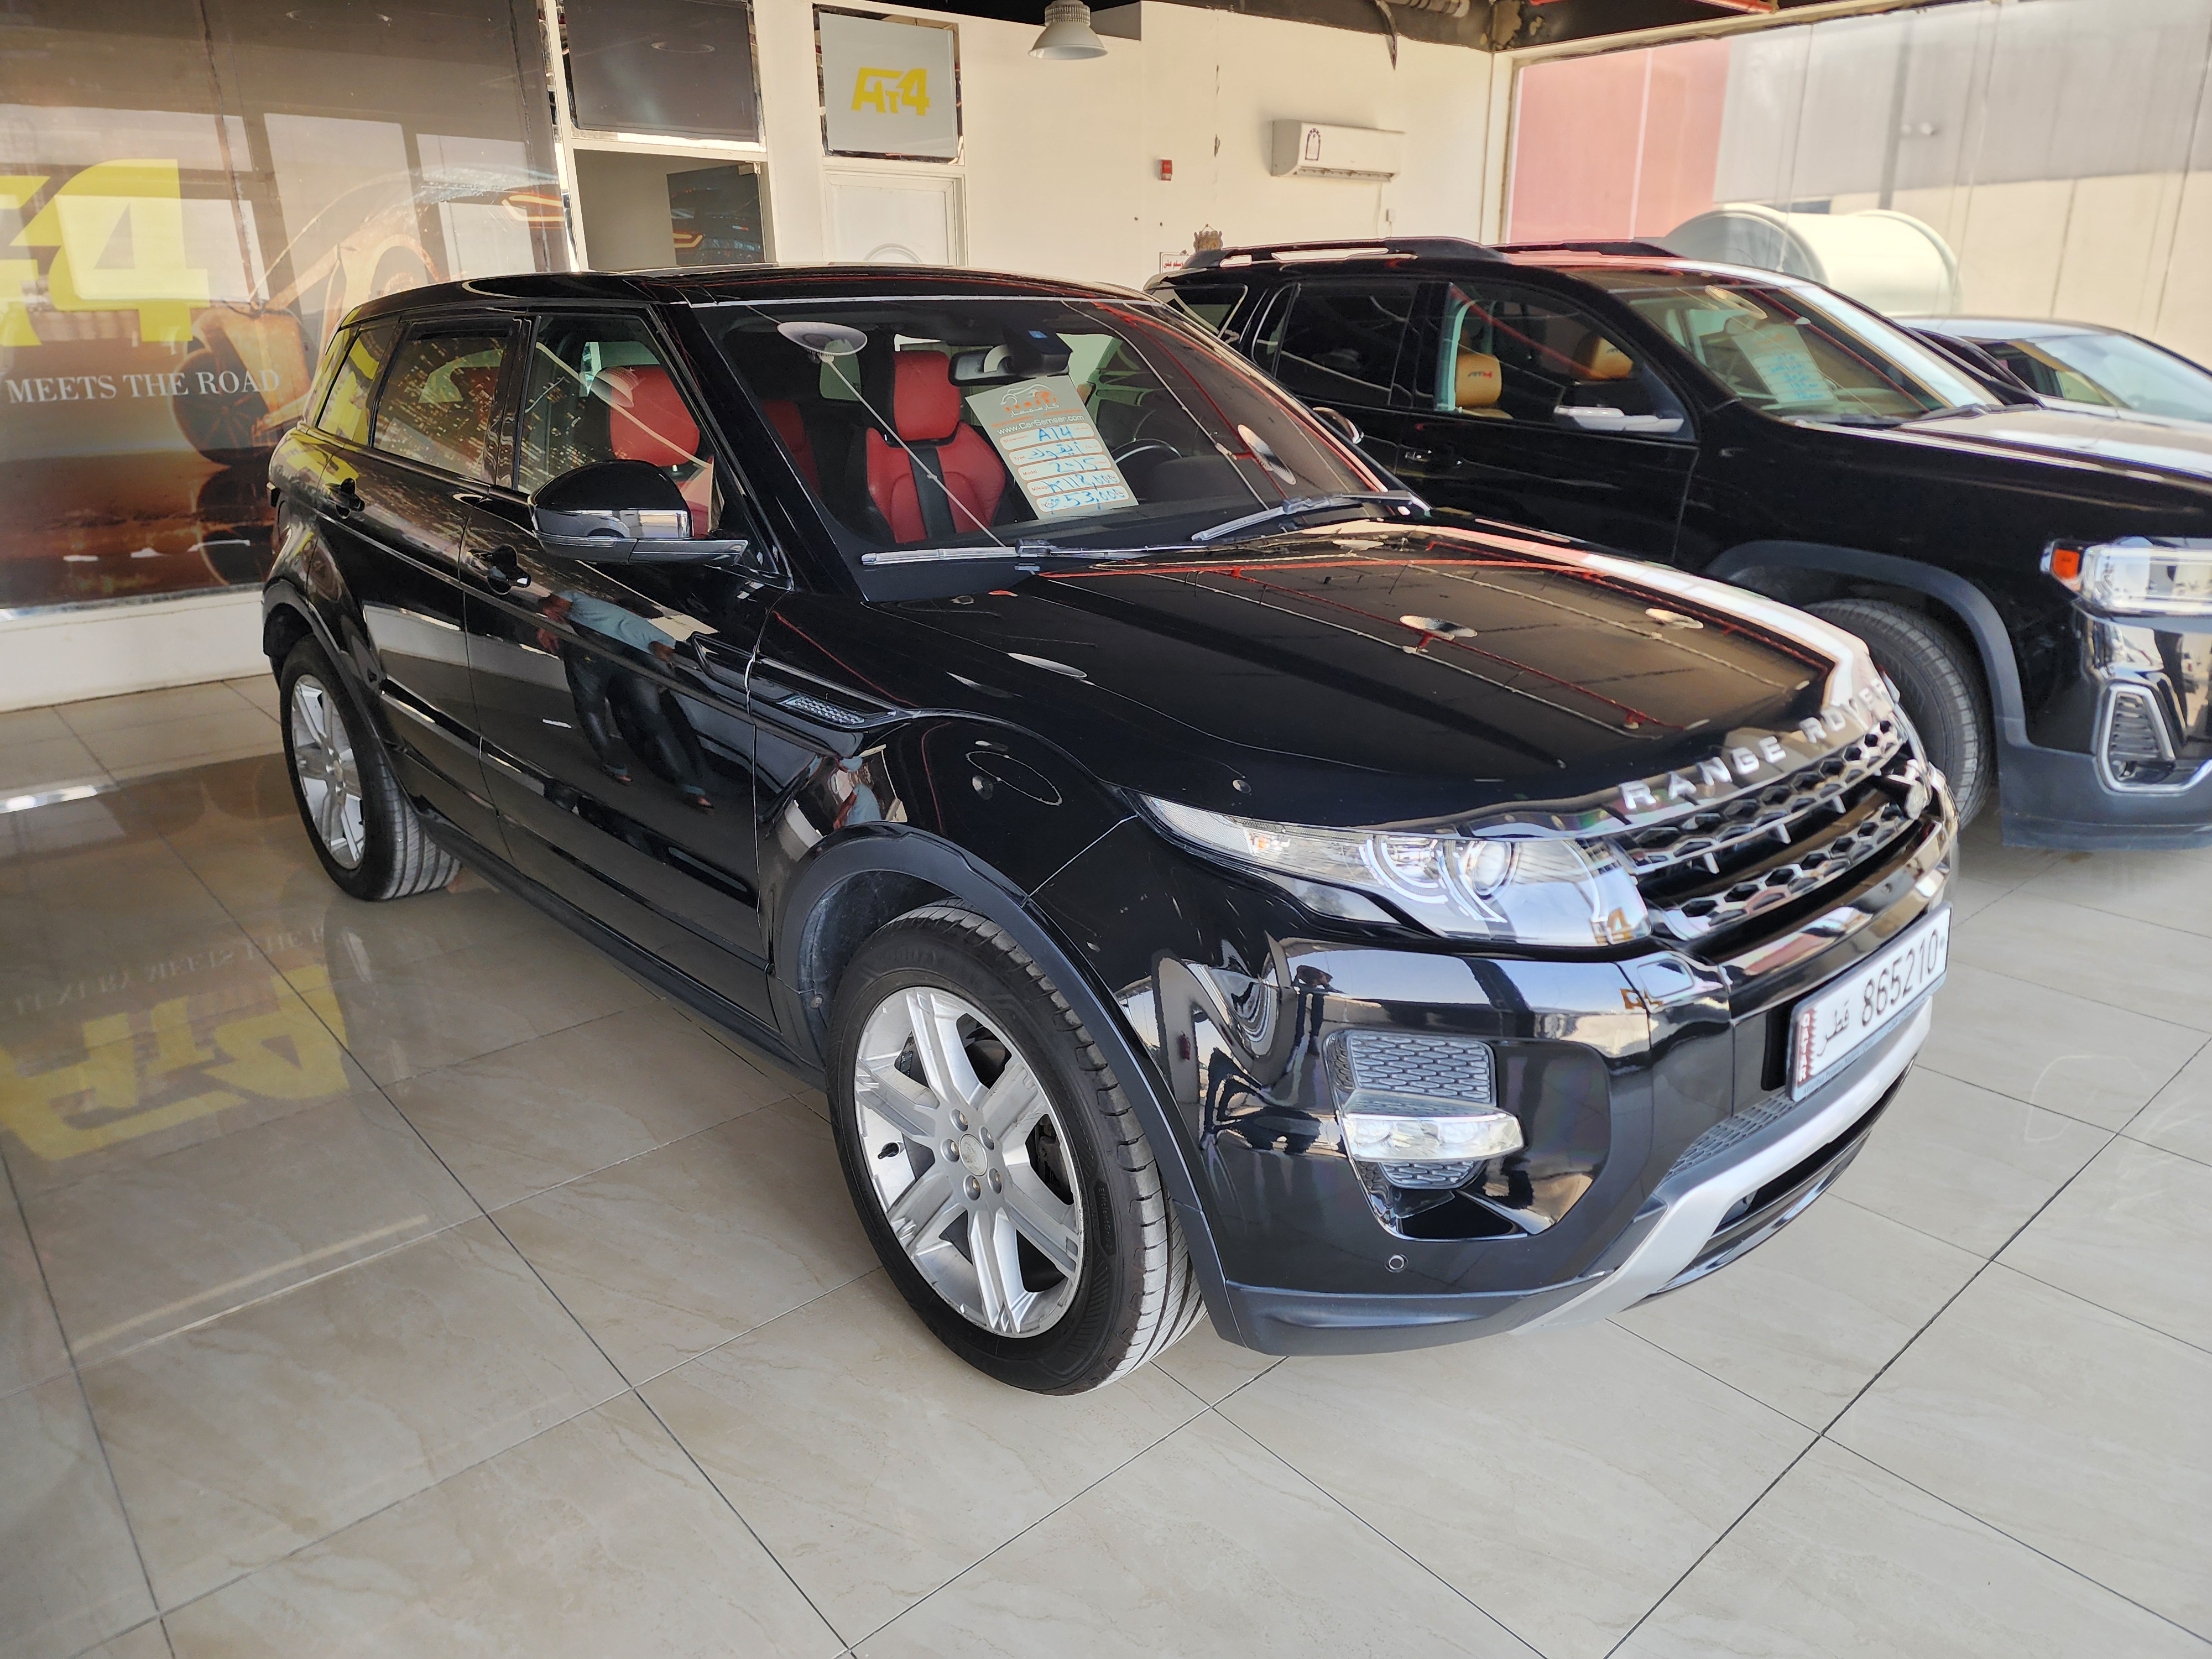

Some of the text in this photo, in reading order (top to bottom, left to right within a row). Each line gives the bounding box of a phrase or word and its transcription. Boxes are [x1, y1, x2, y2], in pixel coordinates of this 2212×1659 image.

[851, 67, 930, 116] AT4
[5, 370, 280, 404] MEETS THE ROAD
[997, 414, 1085, 435] www.CarSemsar.com
[1619, 736, 1787, 810] RANGE
[1861, 928, 1938, 1027] 865210
[1797, 1013, 1811, 1082] QATAR
[1817, 999, 1850, 1057] قطر
